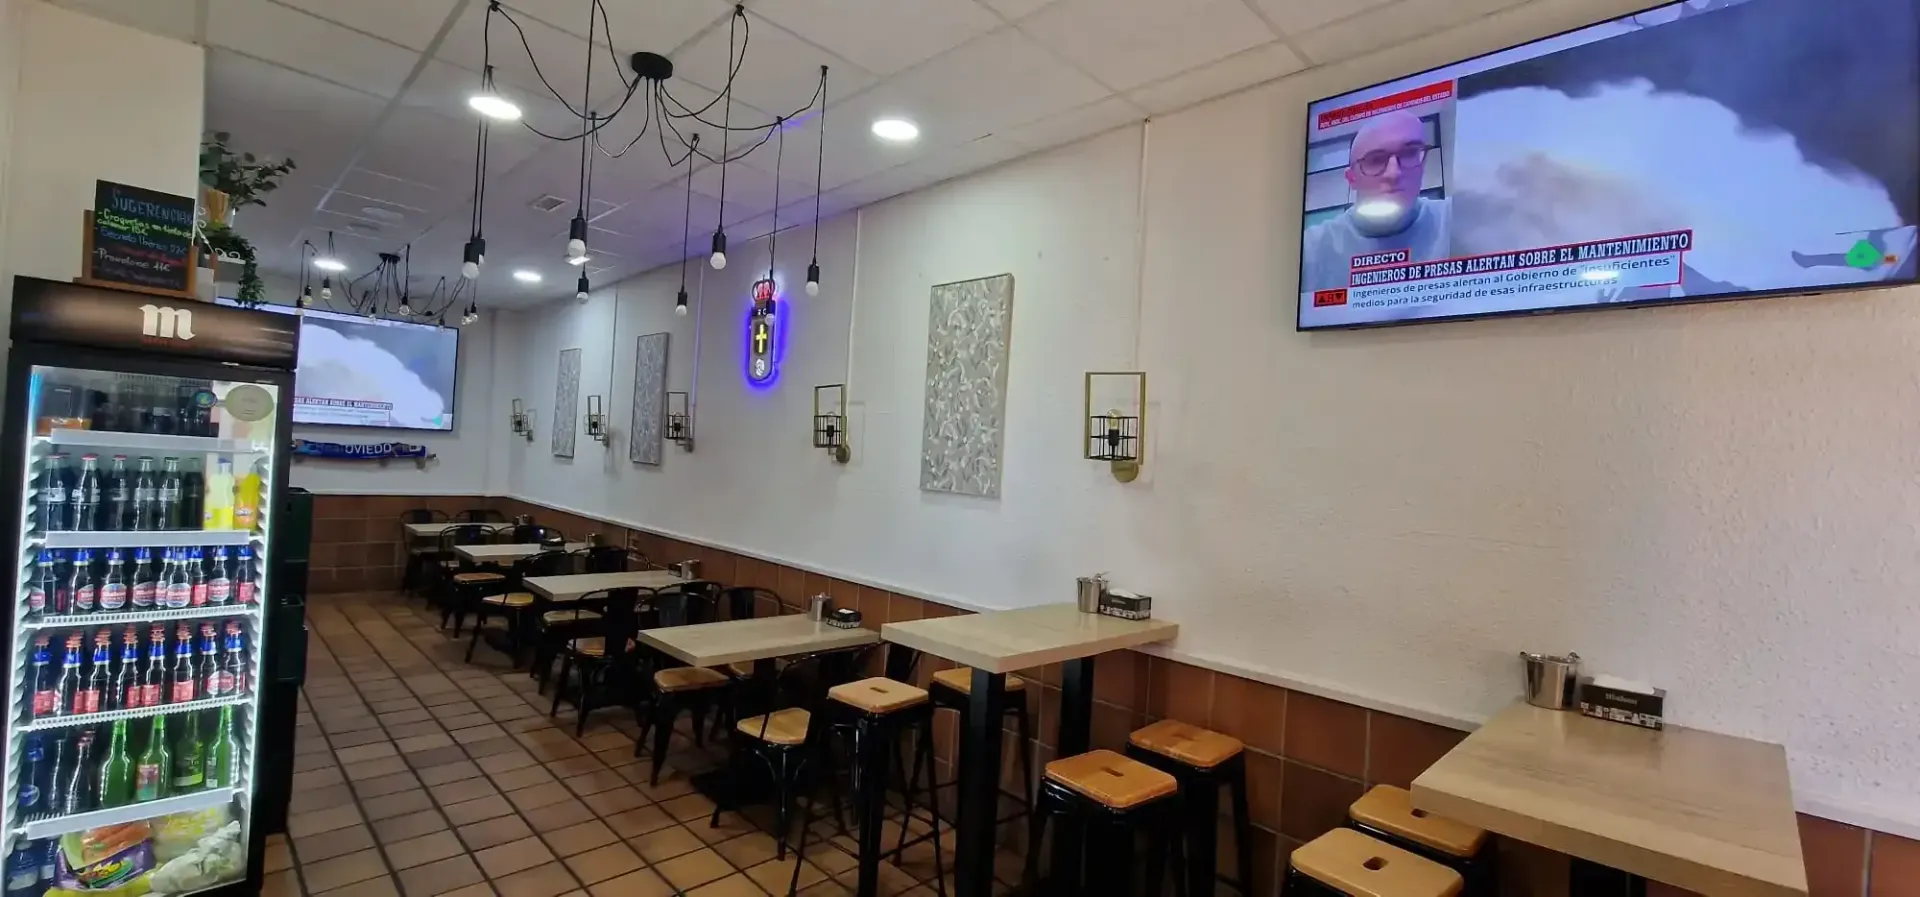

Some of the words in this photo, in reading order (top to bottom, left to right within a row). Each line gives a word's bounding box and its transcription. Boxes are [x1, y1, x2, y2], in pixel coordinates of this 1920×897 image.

[1351, 267, 1406, 286] INGENIEROS
[1408, 266, 1422, 280] DE
[1424, 260, 1463, 278] PRESAS
[1466, 254, 1516, 273] ALERTAN
[1518, 249, 1556, 267] SOBRE
[1560, 247, 1574, 262] EL
[1578, 232, 1689, 261] MANTENIMIENTO
[1353, 251, 1406, 267] DIRECTO
[1353, 286, 1401, 300] Ingenieros
[1403, 284, 1416, 293] de
[1417, 281, 1451, 294] presas
[1452, 275, 1491, 288] alertan
[1493, 273, 1503, 284] al
[1505, 267, 1559, 283] Gobierno
[1562, 266, 1577, 277] de
[1352, 297, 1385, 310] medios
[1387, 297, 1409, 308] para
[1410, 294, 1419, 304] la
[1421, 290, 1472, 305] seguridad
[1474, 287, 1488, 298] de
[1490, 286, 1515, 296] esas
[344, 443, 392, 455] OVIEDO
